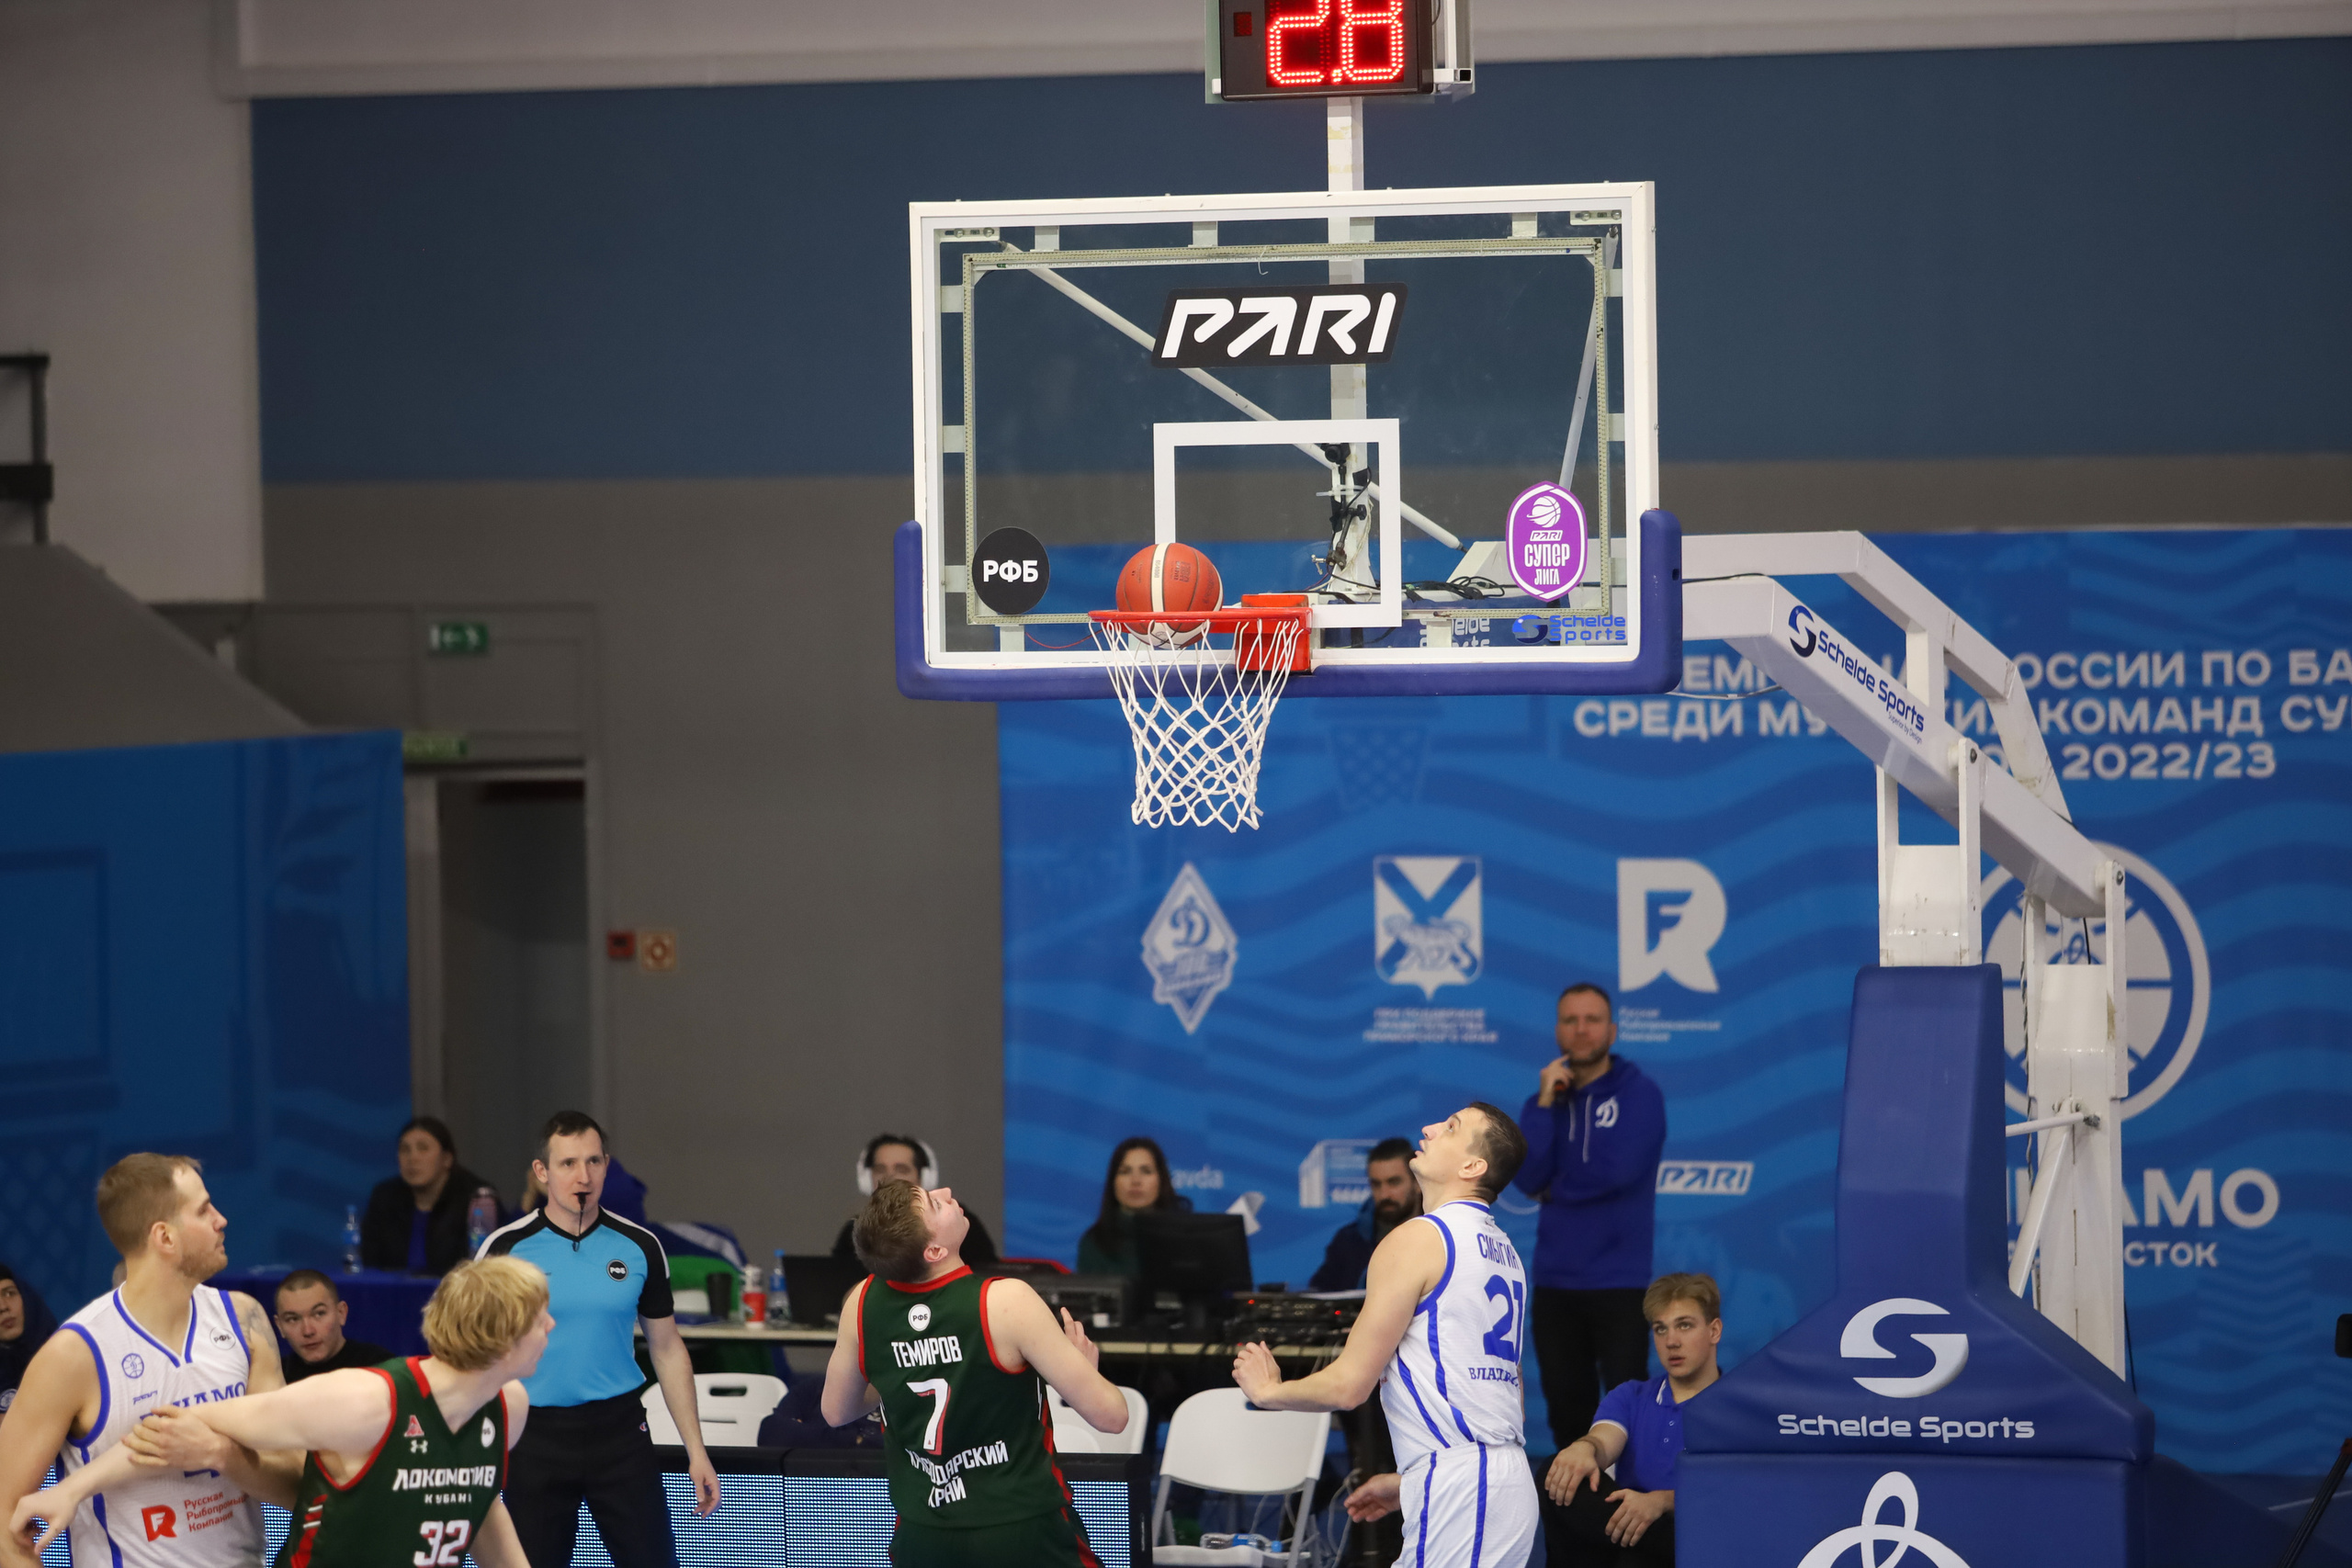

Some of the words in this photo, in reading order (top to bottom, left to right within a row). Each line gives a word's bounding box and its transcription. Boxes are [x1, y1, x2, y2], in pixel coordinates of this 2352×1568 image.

[1268, 0, 1404, 85] 2.8
[1161, 292, 1396, 358] PARI
[1532, 531, 1561, 540] PARI
[983, 559, 1039, 582] РФБ
[1534, 569, 1560, 585] ЛИГА
[1549, 615, 1626, 628] Schelde
[1549, 628, 1626, 645] Sports
[1817, 630, 1875, 694] Schelde
[1877, 679, 1924, 733] Sports
[2011, 651, 2185, 690] ОССИИ
[2203, 650, 2271, 688] ПО
[1573, 701, 1744, 742] СРЕДИ
[2038, 696, 2265, 738] КОМАНД
[2279, 694, 2352, 734] СУ
[2062, 741, 2277, 781] 2022/23
[1659, 1167, 1747, 1189] PARI
[912, 1313, 929, 1322] РФБ
[1484, 1274, 1523, 1367] 21
[890, 1335, 963, 1369] ТЕМИРОВ
[906, 1378, 951, 1456] 7
[1777, 1414, 1912, 1438] Schelde
[1918, 1416, 2035, 1444] Sports
[391, 1465, 496, 1492] ЛОКОМОТИВ
[184, 1491, 224, 1510] Русская
[413, 1519, 471, 1567] 32
